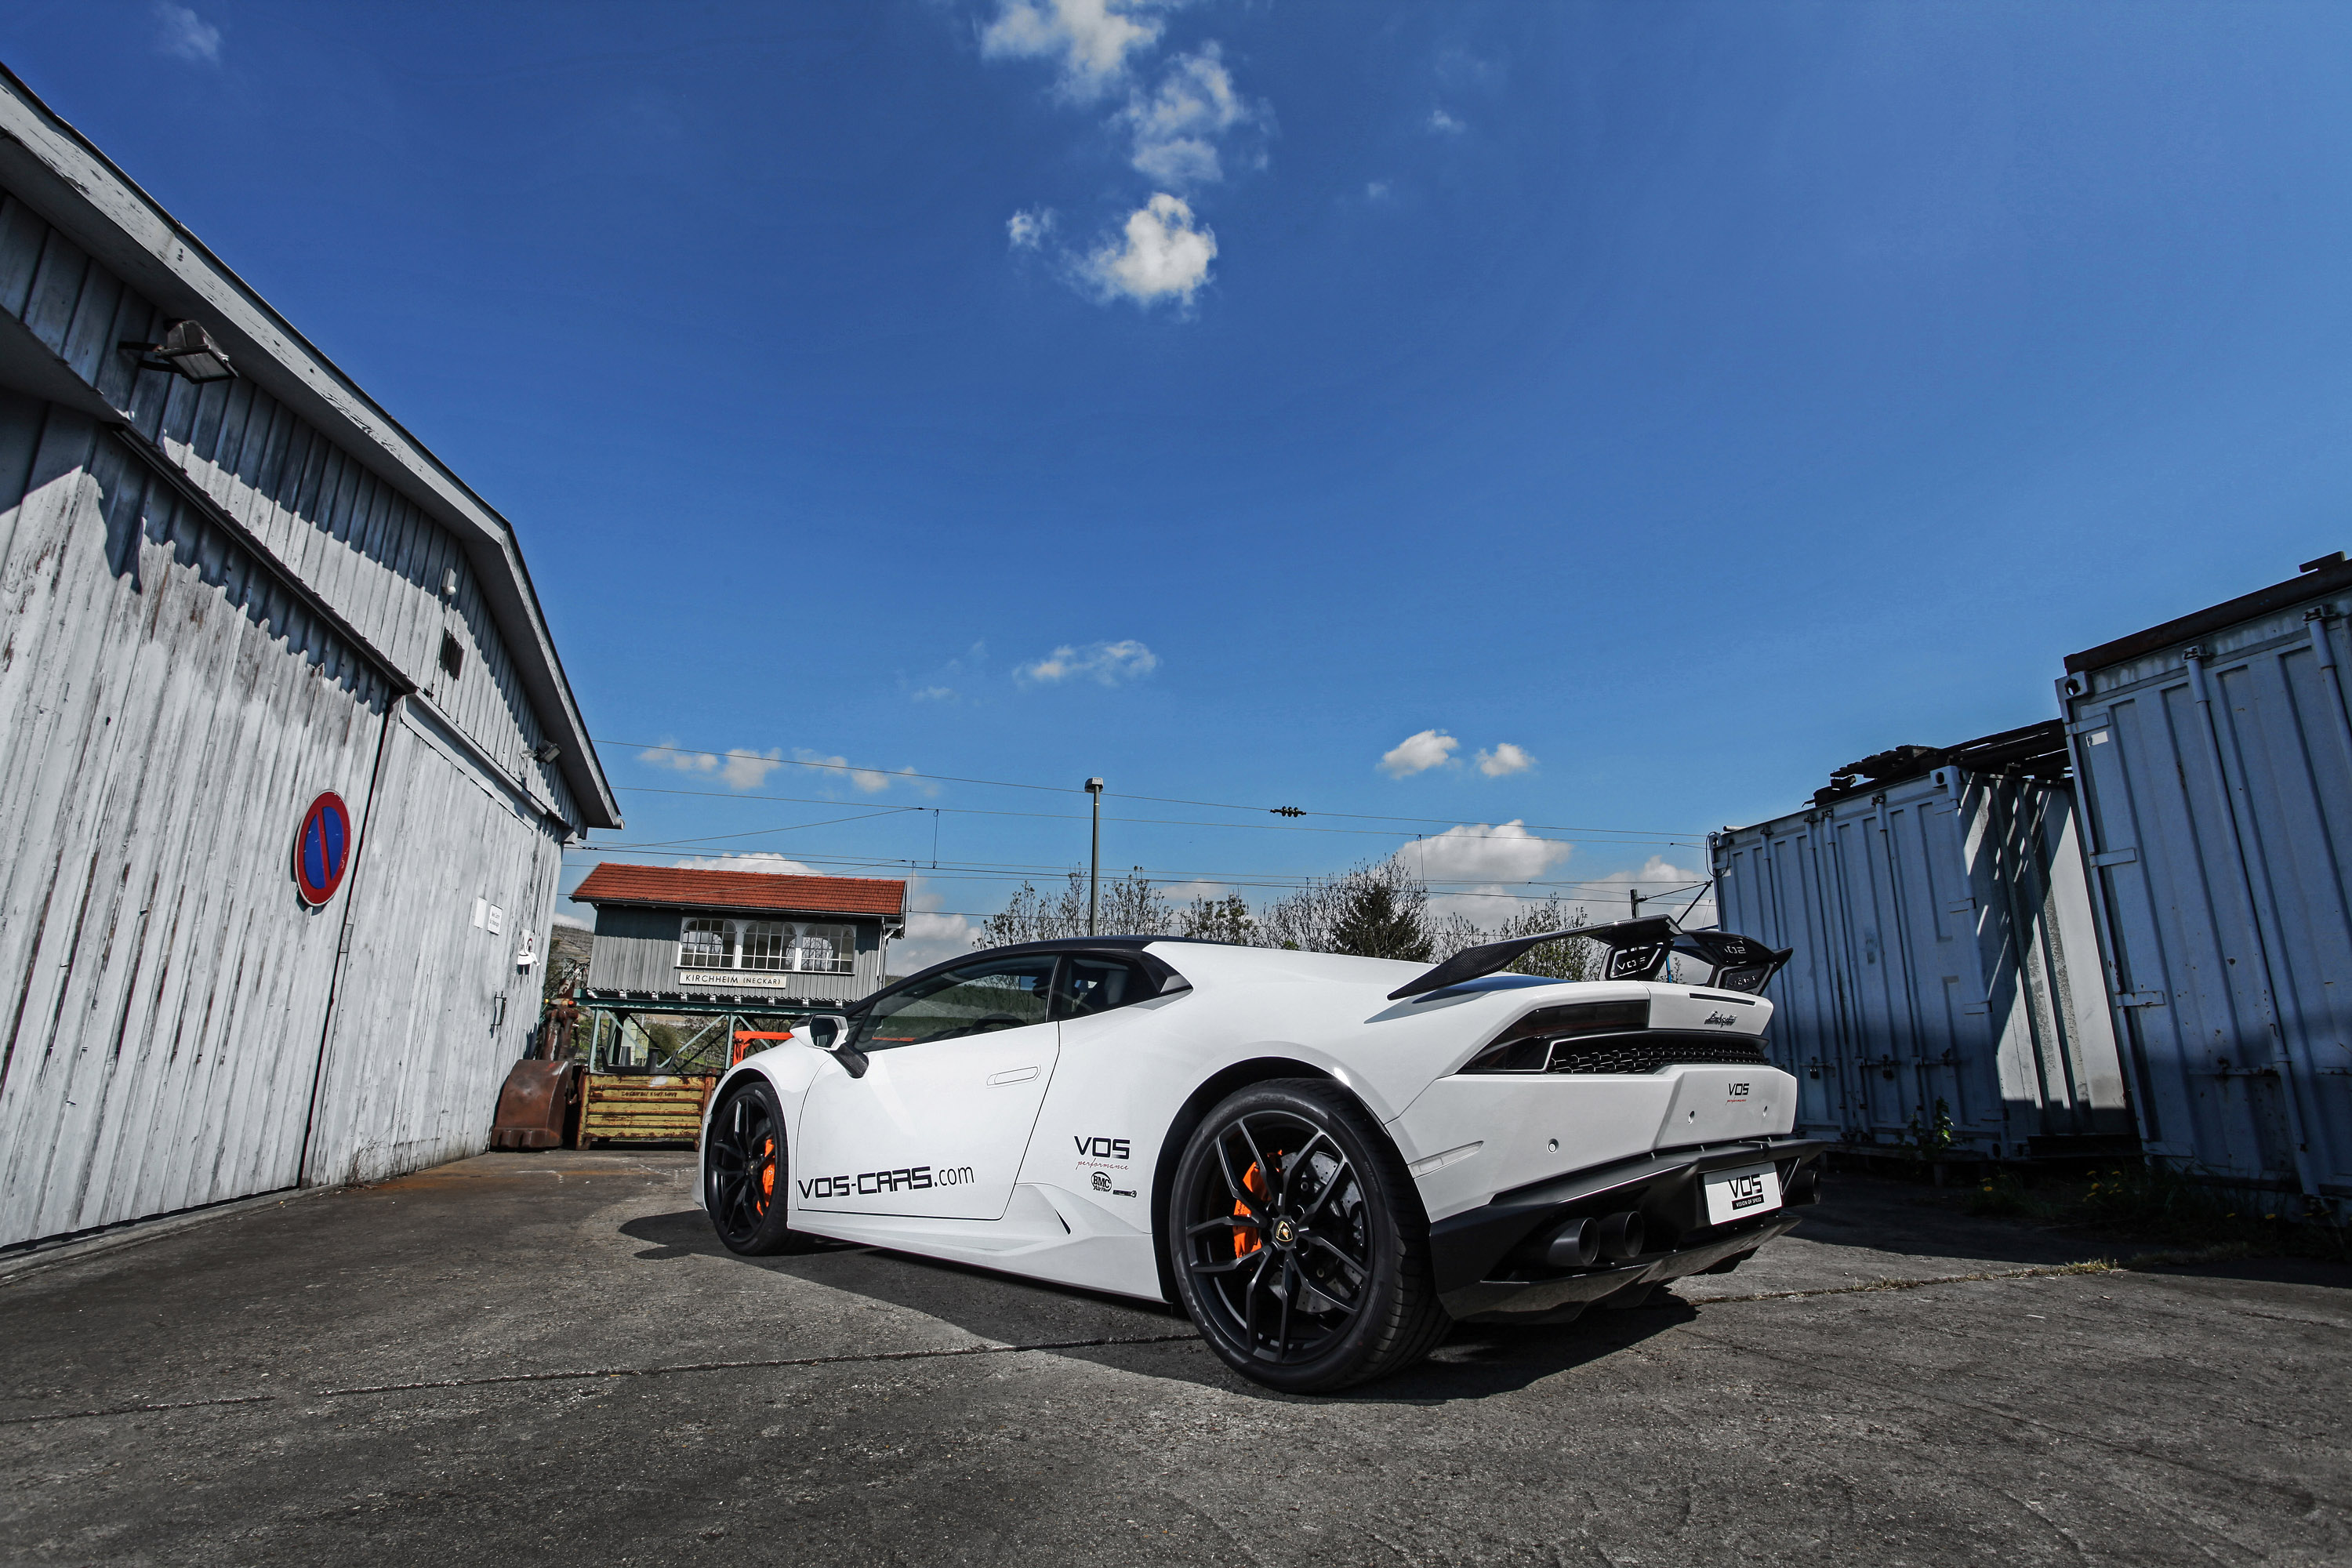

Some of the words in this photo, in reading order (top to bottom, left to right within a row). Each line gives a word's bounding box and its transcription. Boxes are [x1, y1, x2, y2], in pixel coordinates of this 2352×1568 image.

[685, 975, 739, 984] KIRCHHEIM
[1728, 1083, 1750, 1096] VOS
[1074, 1135, 1130, 1160] VOS
[1075, 1157, 1129, 1171] performance
[797, 1166, 975, 1199] VOS-CARS.com
[1093, 1174, 1111, 1189] BMC
[1727, 1173, 1763, 1198] VOS
